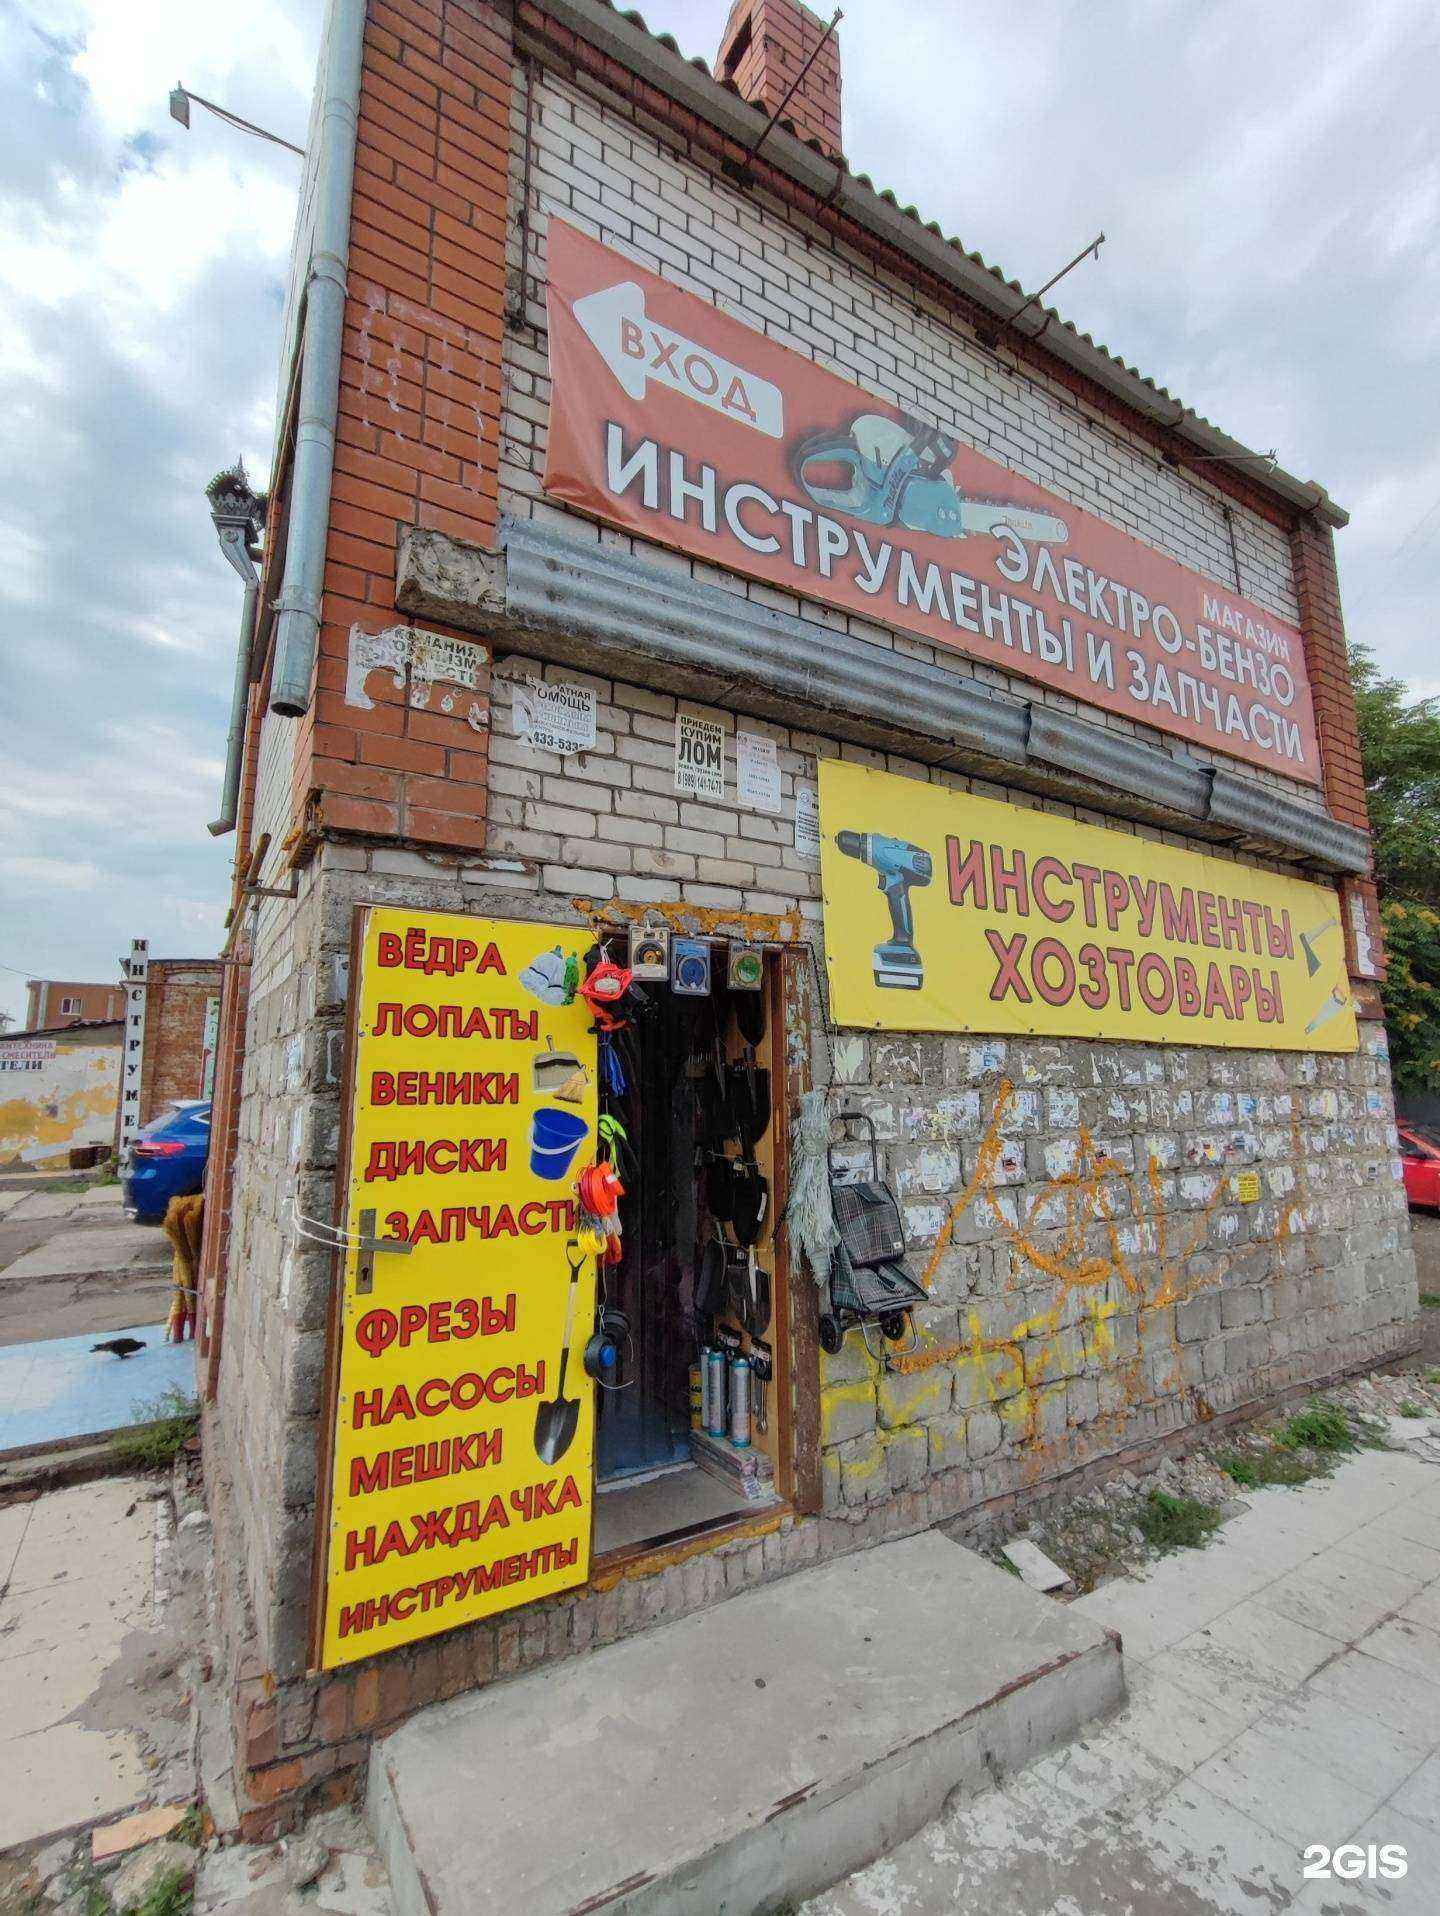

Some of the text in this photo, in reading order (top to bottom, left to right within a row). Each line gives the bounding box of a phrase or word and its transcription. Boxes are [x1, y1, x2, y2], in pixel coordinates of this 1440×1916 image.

[620, 314, 757, 422] ВХОД
[605, 421, 1304, 762] ИНСТРУМЕНТЫ И ЗАПЧАСТИ
[990, 524, 1296, 708] ЭЛЕКТРО-БЕНЗО
[1203, 594, 1291, 663] МАГАЗИН
[537, 688, 591, 712] ОМОЩЬ
[557, 685, 591, 701] АТНАЯ
[680, 715, 722, 734] ПРИЕДЕМ
[678, 737, 721, 771] ЛОМ
[680, 725, 722, 746] КУПИМ
[944, 833, 1295, 961] ИНСТРУМЕНТЫ
[377, 926, 508, 978] ВЁДРА
[984, 928, 1285, 1025] ХОЗТОВАРЫ
[119, 938, 148, 1170] ИНСТРУМЕ
[371, 1002, 539, 1041] ЛОПАТЫ
[370, 1070, 520, 1107] ВЕНИКИ
[363, 1137, 508, 1184] ДИСКИ
[354, 1293, 517, 1358] ФРЕЗЫ
[351, 1360, 546, 1431] НАСОСЫ
[348, 1428, 503, 1498] МЕШКИ
[344, 1474, 583, 1573] НАЖДАЧКА
[337, 1536, 579, 1640] ИНСТРУМЕНТЫ
